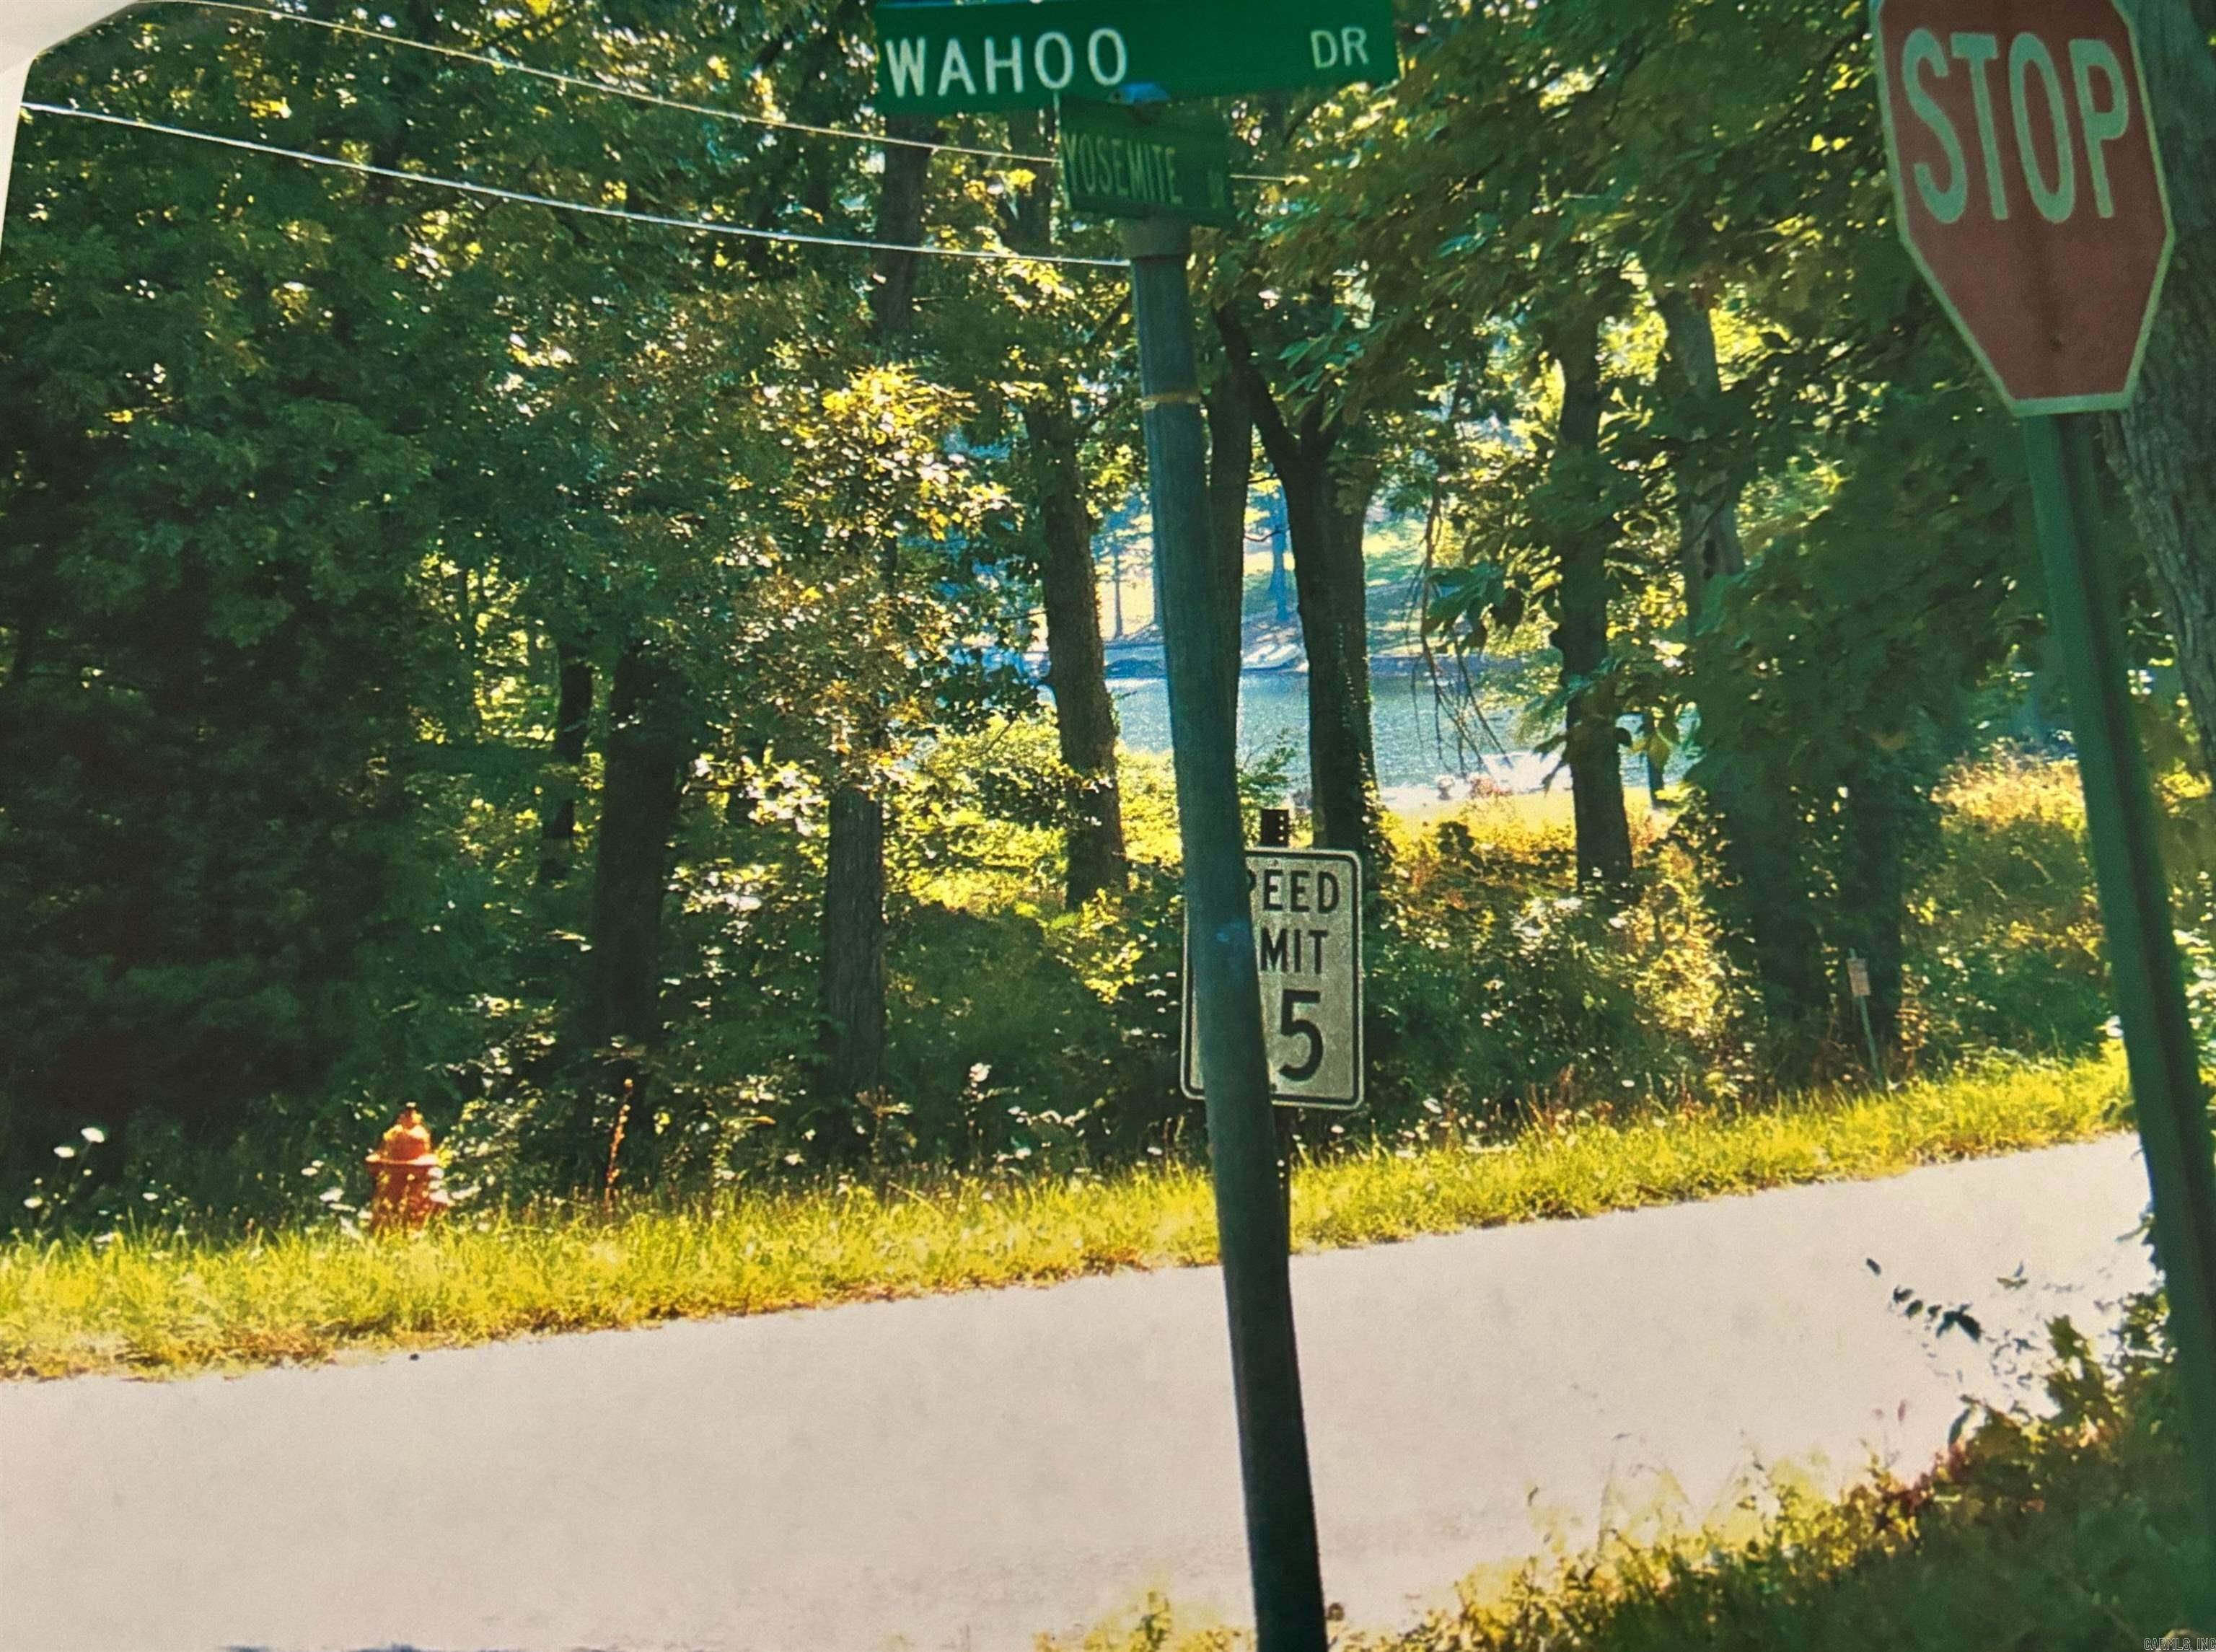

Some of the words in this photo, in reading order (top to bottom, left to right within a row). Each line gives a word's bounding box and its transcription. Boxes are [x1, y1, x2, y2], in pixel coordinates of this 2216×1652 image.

[884, 28, 1127, 97] WAHOO
[1309, 26, 1370, 70] DR
[1901, 27, 2129, 224] STOP
[1061, 132, 1184, 206] YOSEMITE
[1248, 869, 1340, 914] EED
[1260, 928, 1328, 974] MIT
[1278, 989, 1324, 1081] 5
